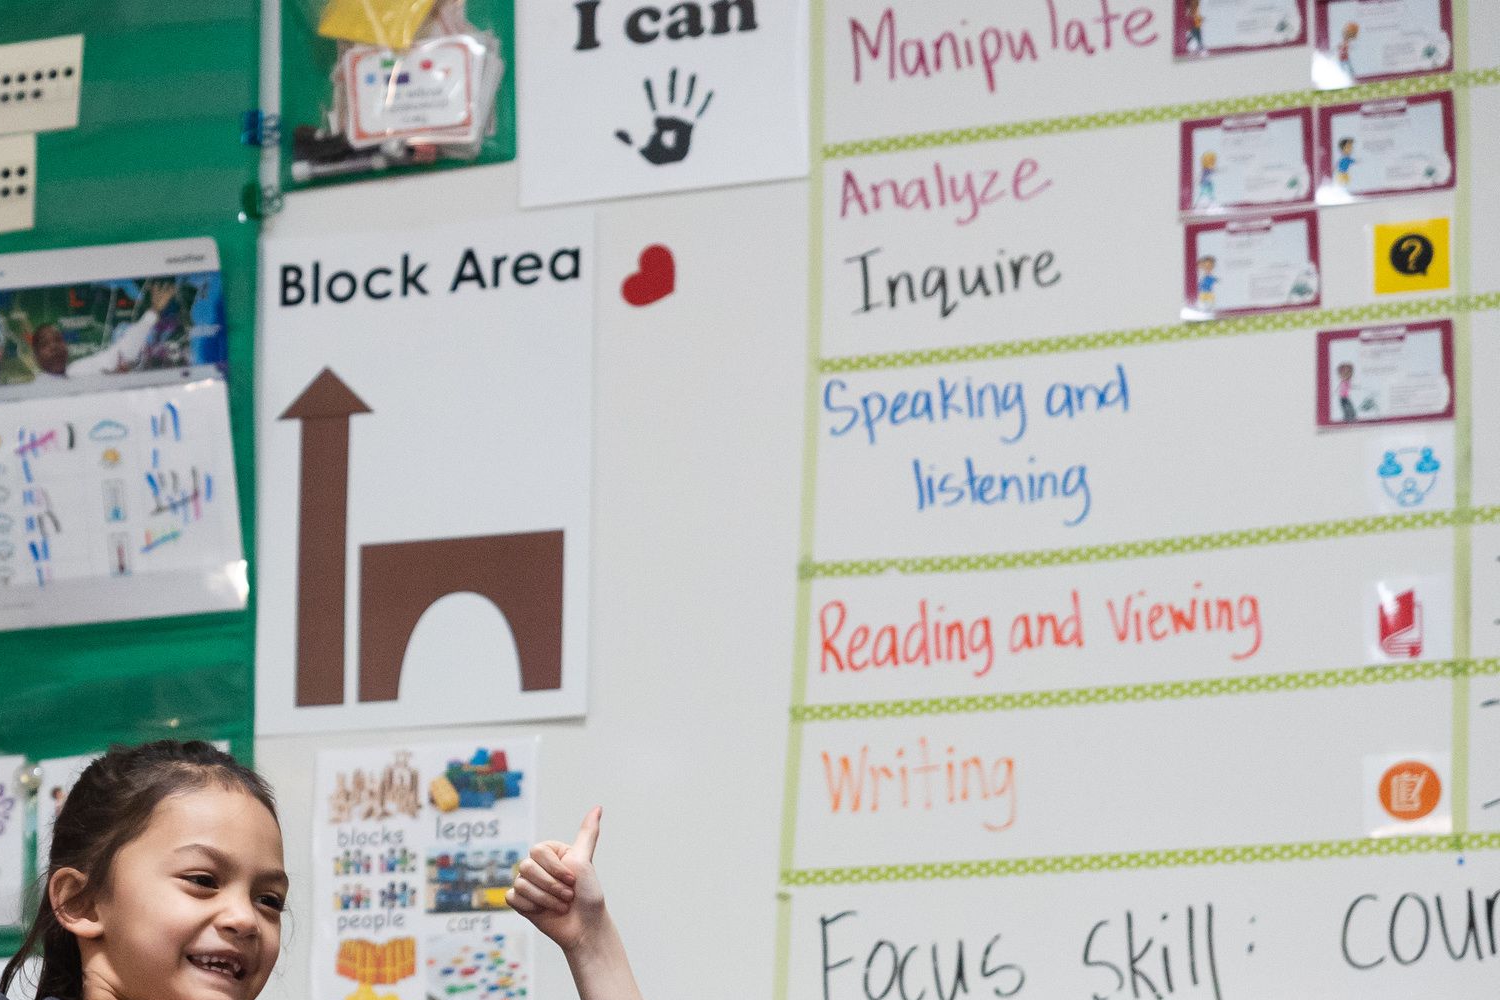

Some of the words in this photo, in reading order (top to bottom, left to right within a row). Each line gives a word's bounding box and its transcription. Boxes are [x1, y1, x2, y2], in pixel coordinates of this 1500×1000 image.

[574, 1, 600, 50] I
[625, 0, 757, 45] can
[849, 0, 1160, 92] Manipulate
[839, 158, 1054, 226] Analyze
[280, 254, 428, 307] Block
[451, 247, 581, 292] Area
[846, 246, 1062, 318] Inquire
[824, 377, 1028, 444] Speaking
[1045, 364, 1130, 420] and
[912, 455, 1092, 527] listening
[819, 599, 996, 678] Reading
[1009, 590, 1086, 656] and
[822, 737, 1017, 832] Writing
[337, 827, 404, 847] blocks
[435, 816, 499, 840] legos
[337, 911, 405, 933] people
[446, 914, 492, 932] cars
